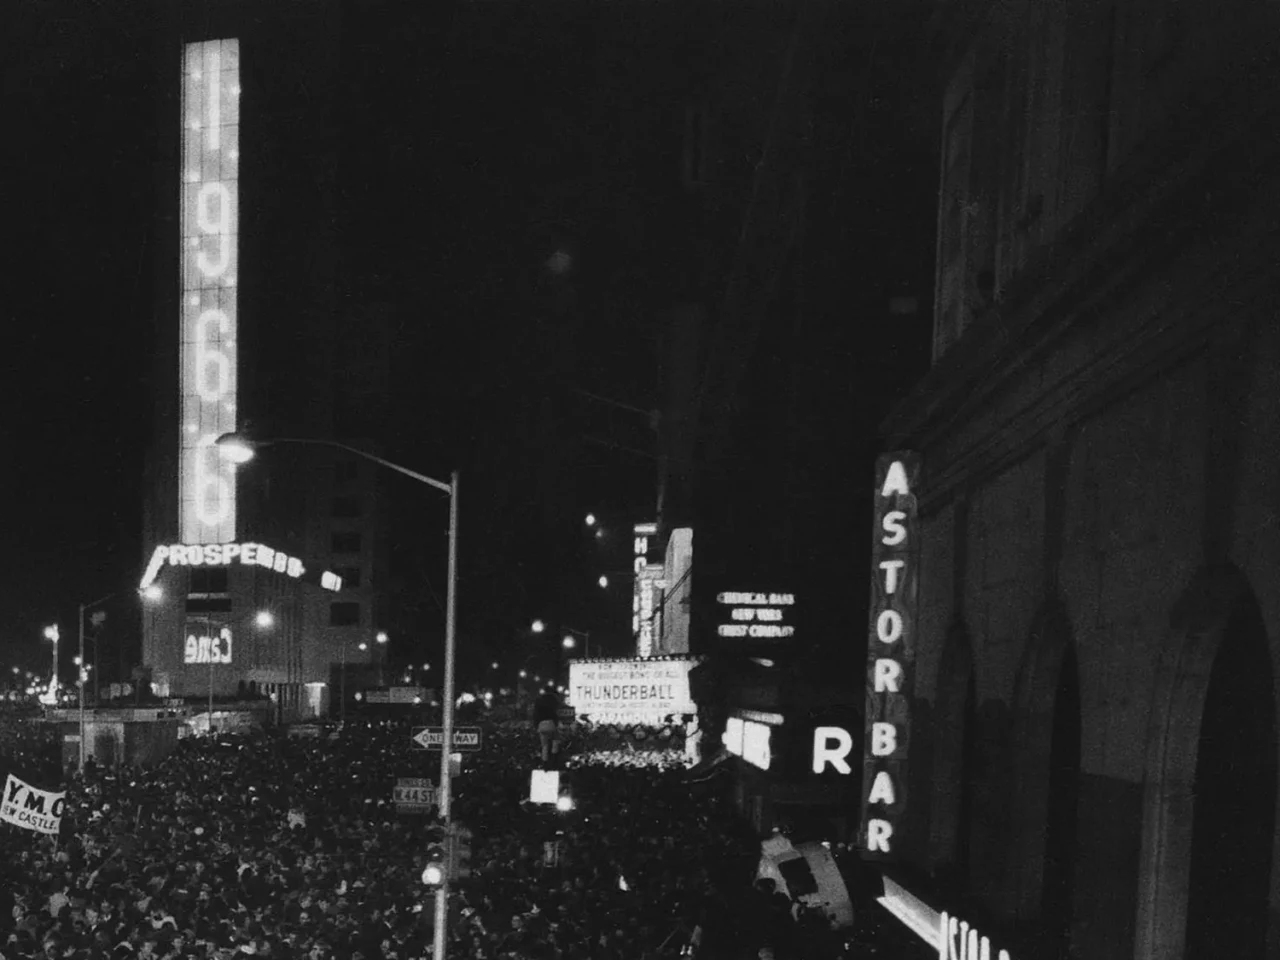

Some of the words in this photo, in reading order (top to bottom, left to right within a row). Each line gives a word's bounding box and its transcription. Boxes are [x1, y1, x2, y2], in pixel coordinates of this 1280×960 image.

[196, 49, 230, 525] 1966
[877, 460, 910, 692] ASTOR
[576, 685, 675, 700] THUNDERBALL
[422, 733, 443, 743] ONE
[456, 733, 477, 744] WAY
[813, 726, 852, 775] R
[421, 791, 435, 802] ST
[866, 722, 898, 853] BAR
